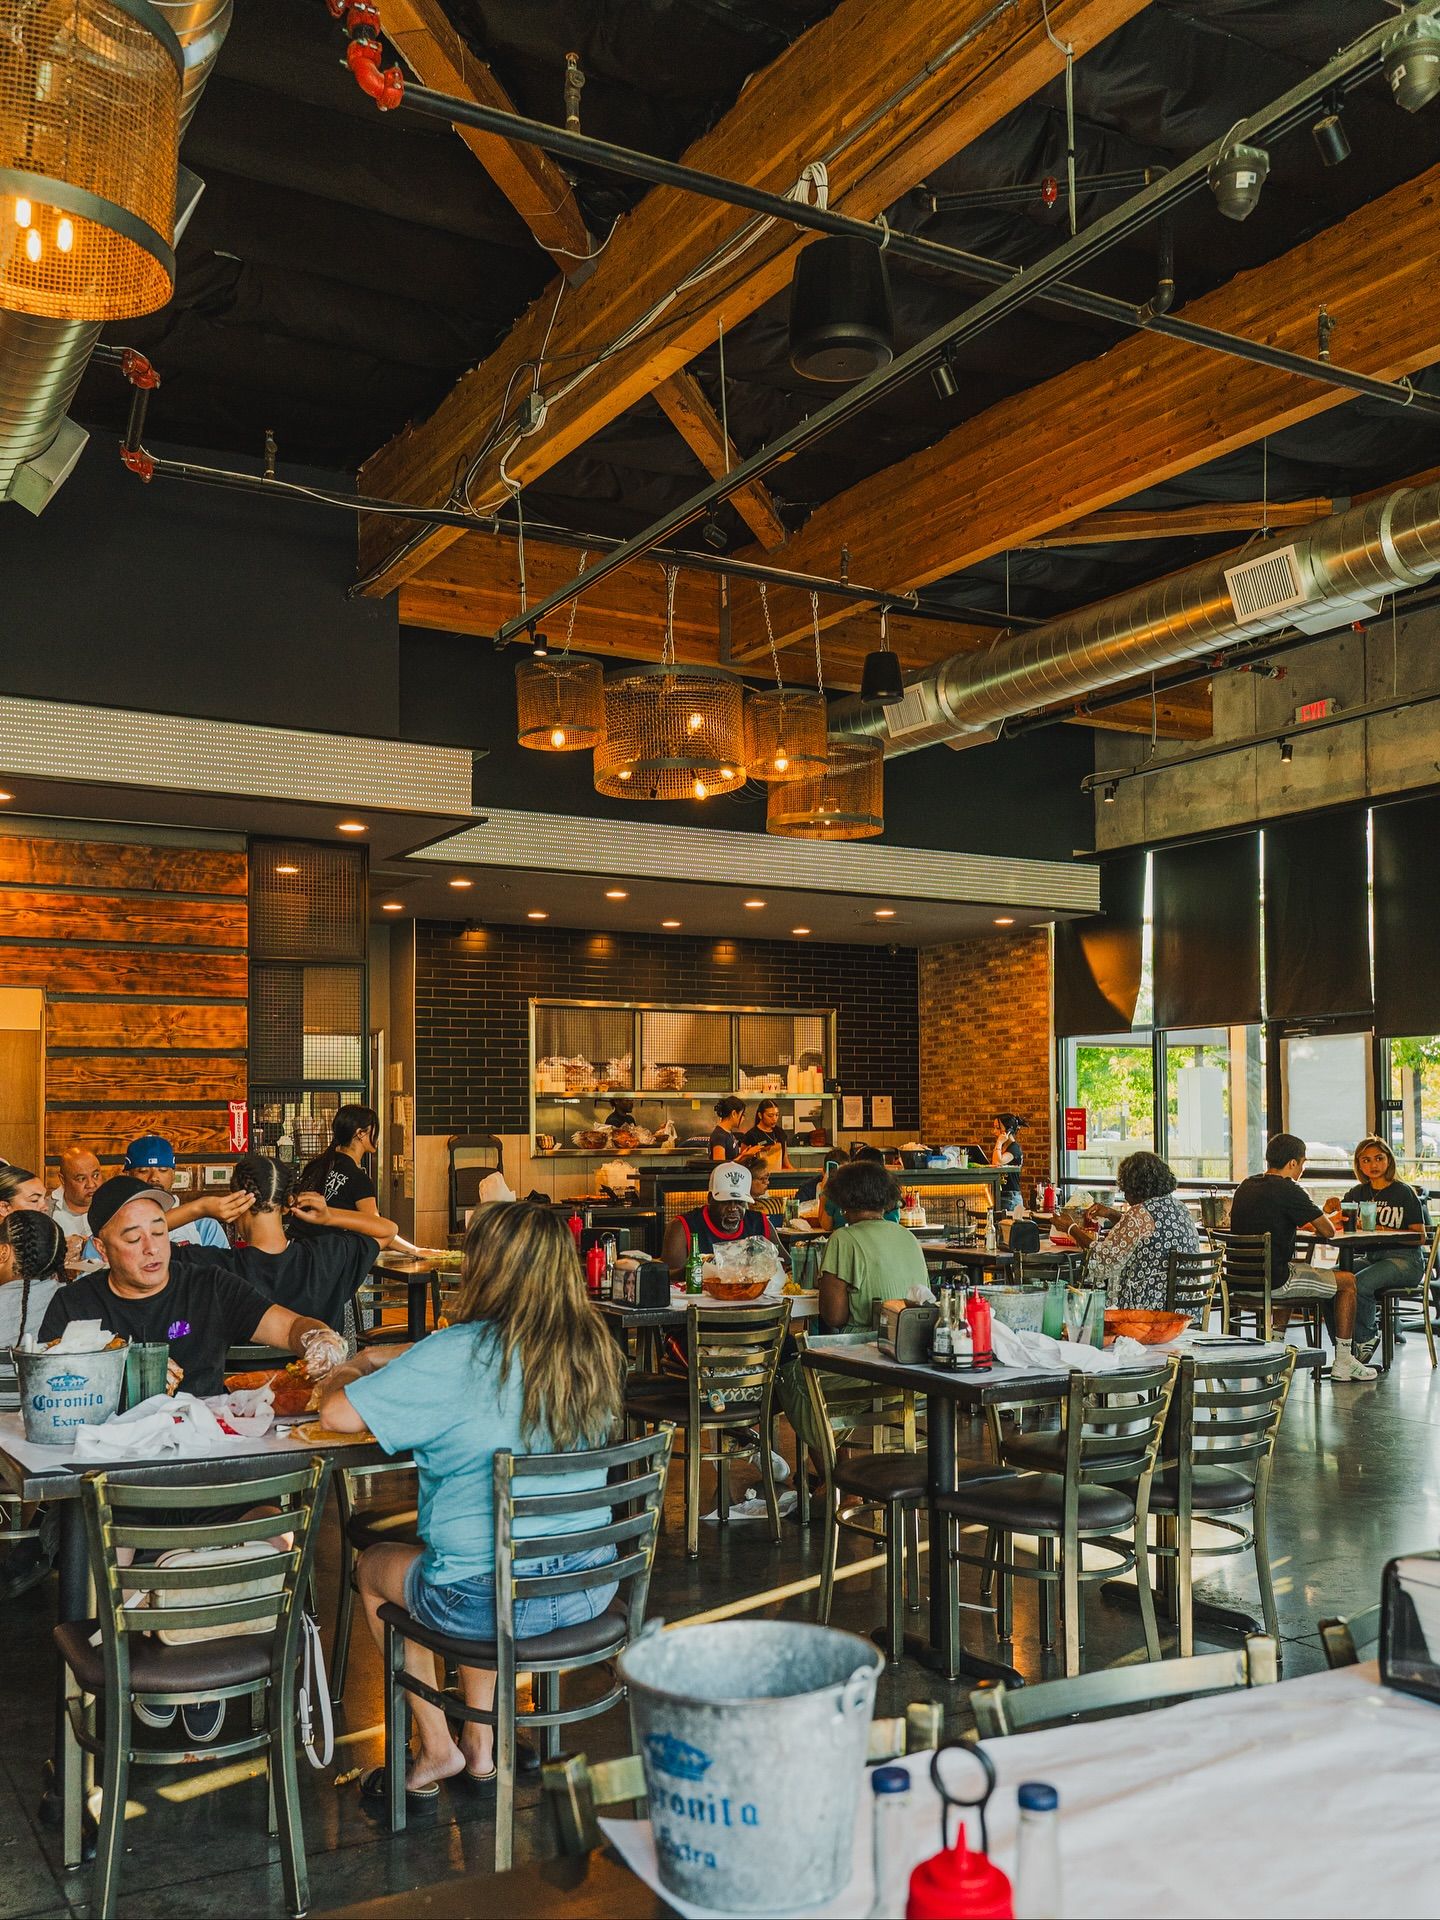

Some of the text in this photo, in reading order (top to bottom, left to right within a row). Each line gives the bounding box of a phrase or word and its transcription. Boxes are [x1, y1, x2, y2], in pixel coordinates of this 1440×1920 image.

[1301, 700, 1328, 721] EXIT
[329, 1170, 349, 1183] RACK
[33, 1392, 104, 1412] Coronita
[53, 1415, 85, 1427] Extra
